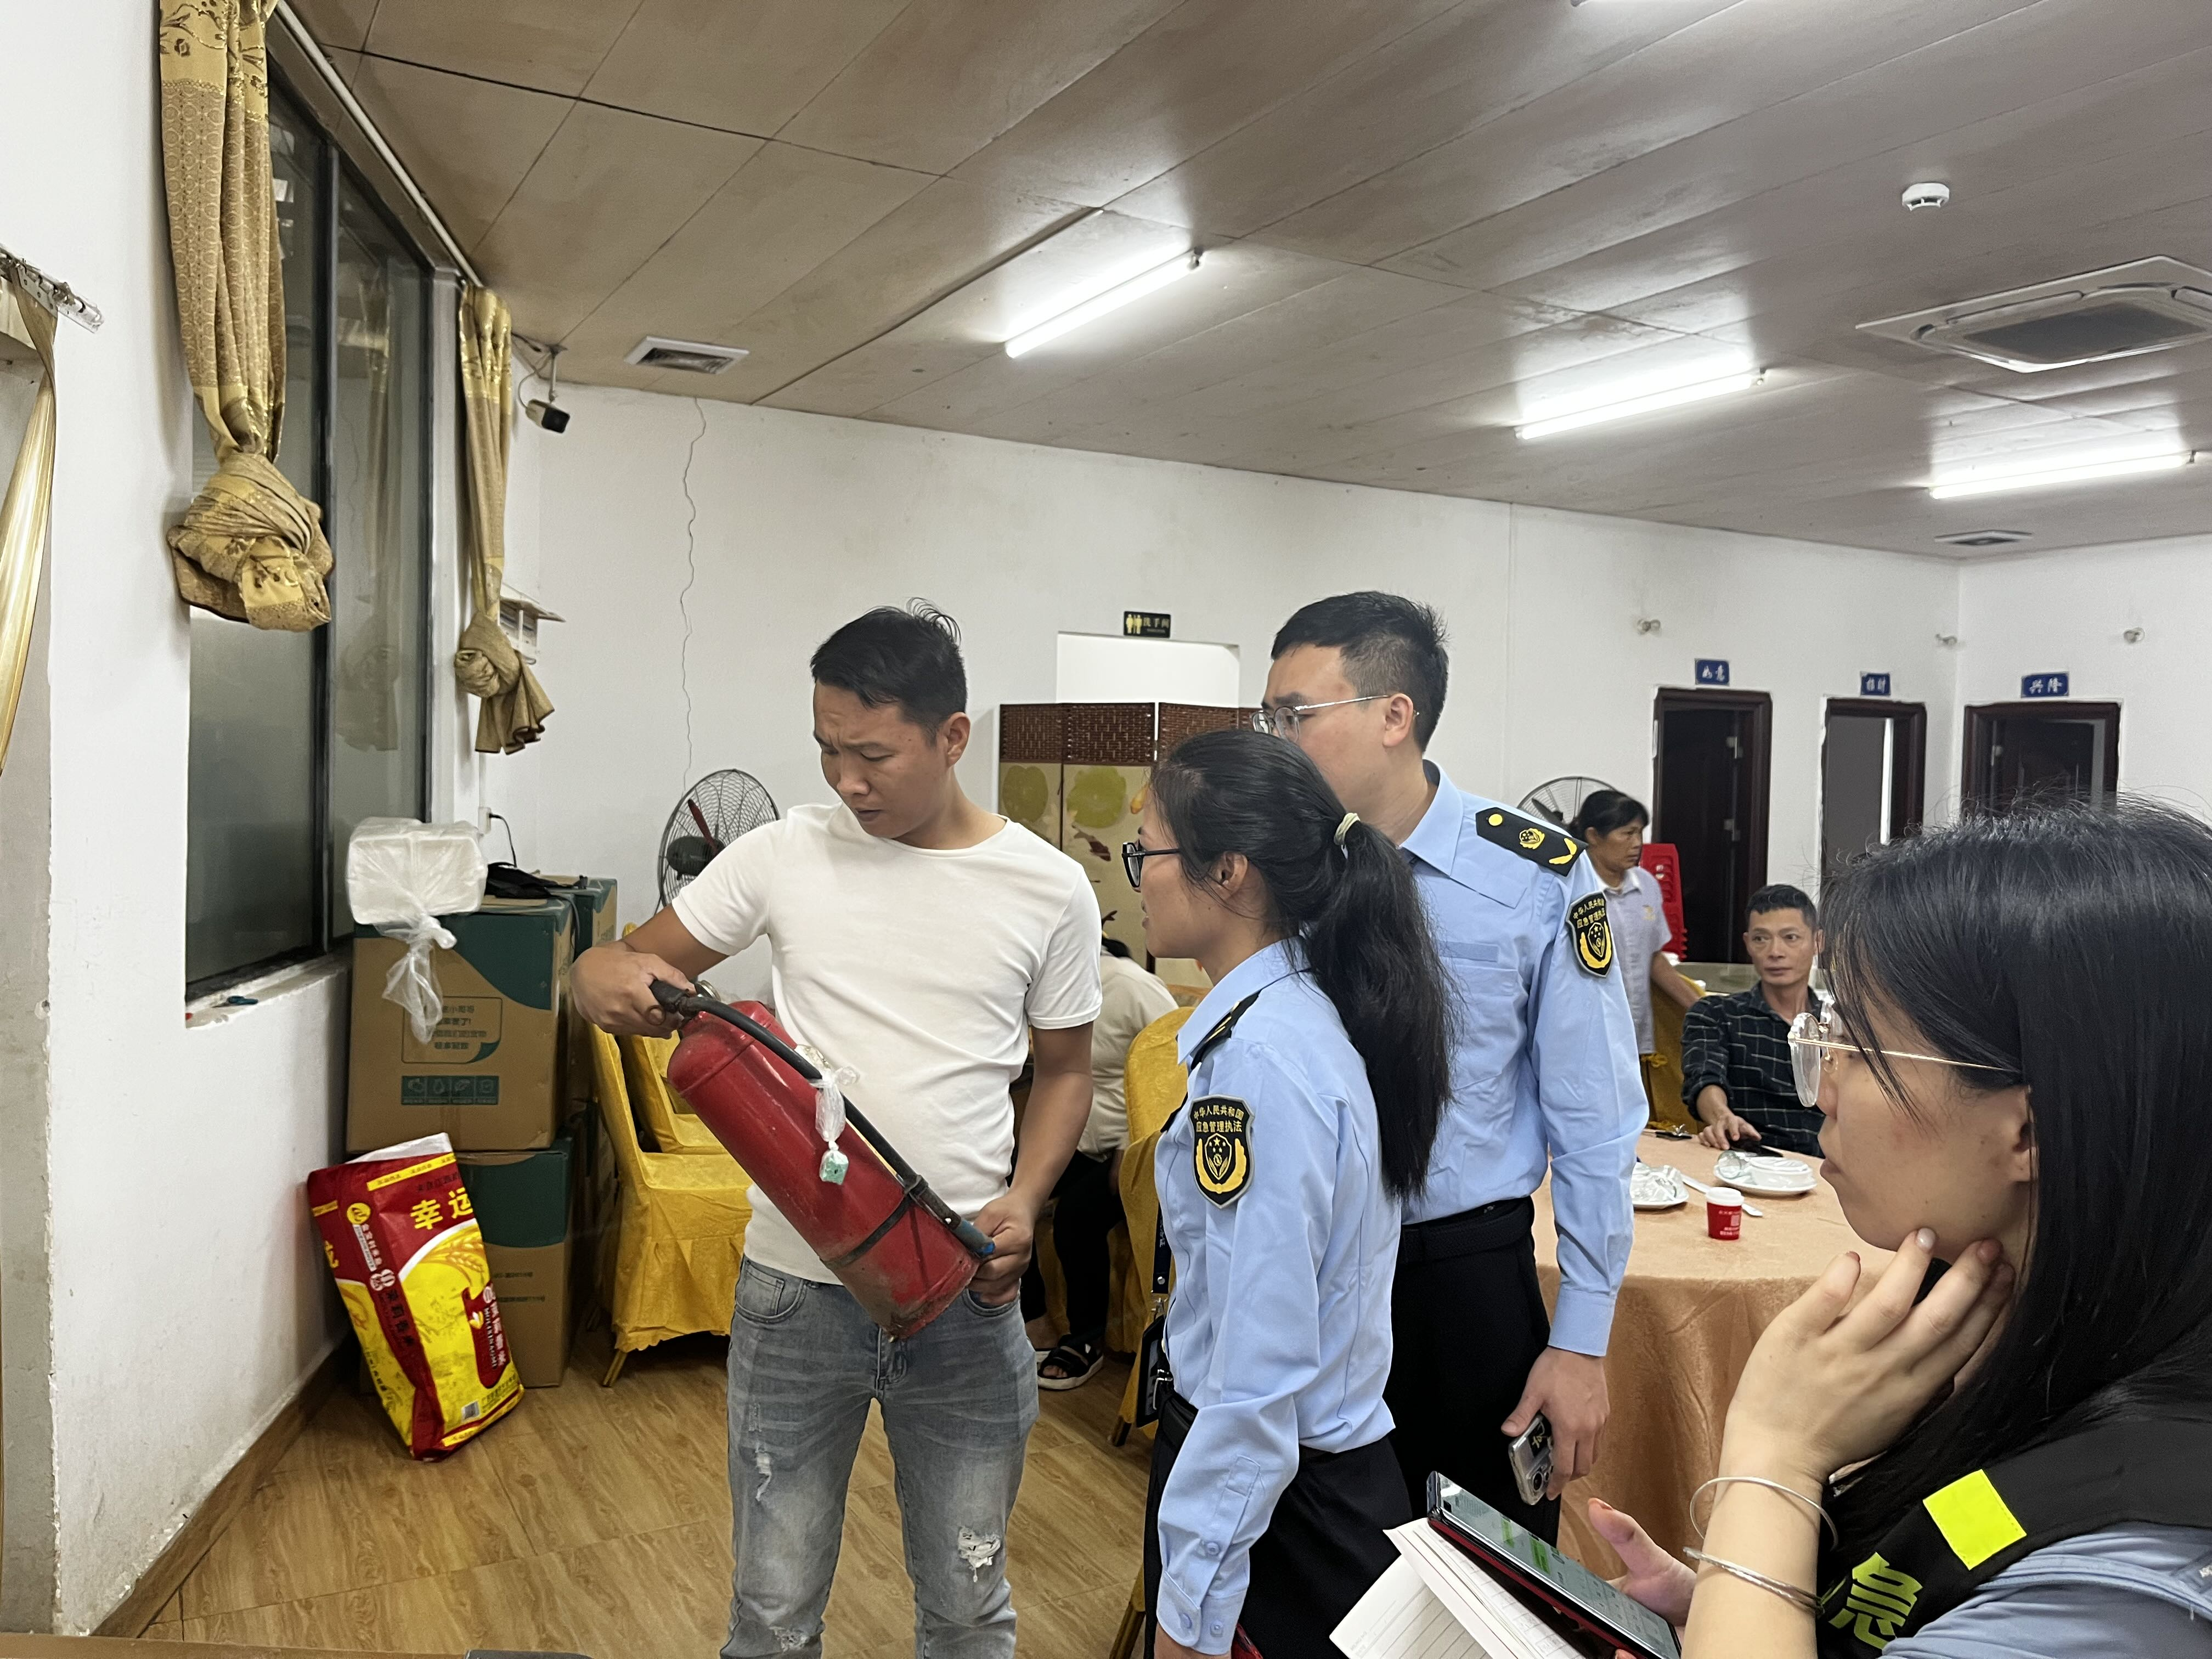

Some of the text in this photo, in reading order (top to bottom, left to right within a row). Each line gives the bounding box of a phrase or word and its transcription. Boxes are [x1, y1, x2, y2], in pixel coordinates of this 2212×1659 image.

[1193, 1104, 1245, 1121] 中华人民共和国
[1196, 1120, 1243, 1133] 应急管理执法
[1820, 1552, 1923, 1650] 急
